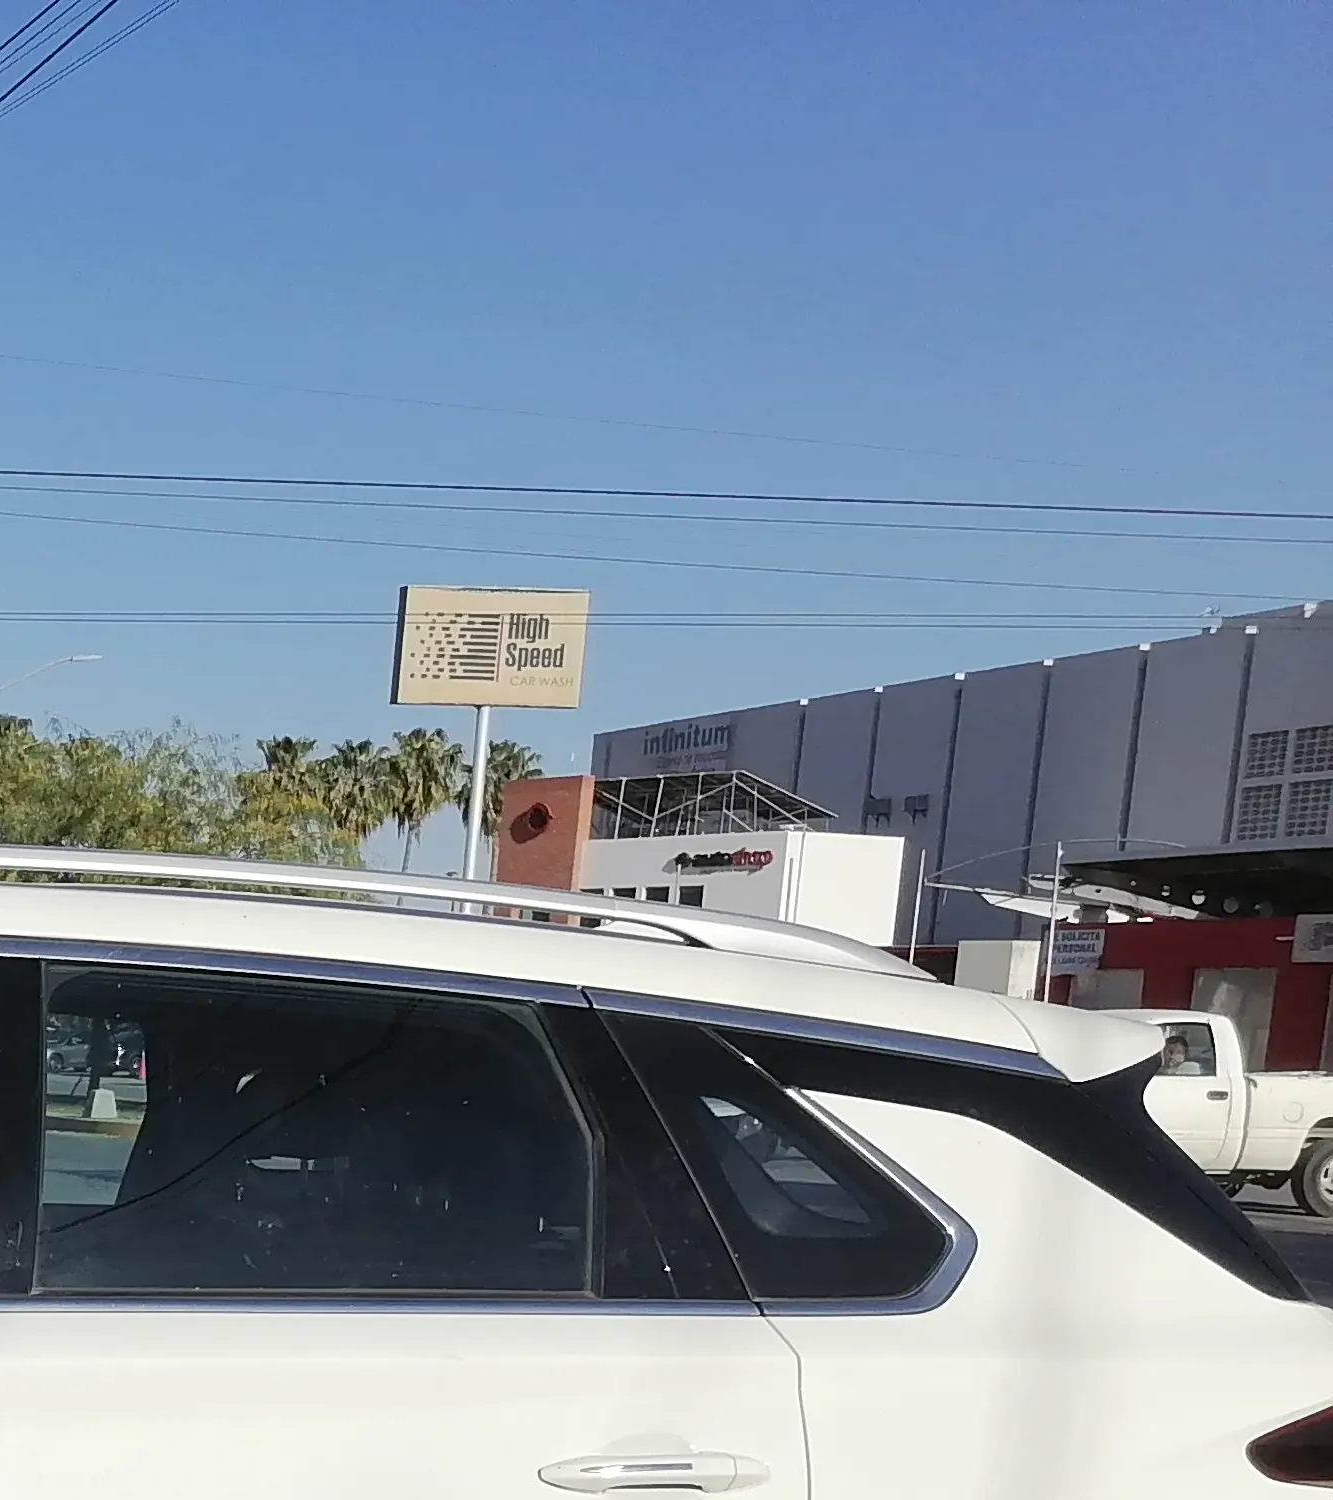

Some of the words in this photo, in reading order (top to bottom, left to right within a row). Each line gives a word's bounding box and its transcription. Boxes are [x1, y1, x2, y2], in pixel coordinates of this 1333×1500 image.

[507, 613, 551, 644] High
[505, 642, 565, 671] Speed
[510, 675, 536, 687] CAR
[539, 676, 574, 687] WASH
[643, 723, 731, 756] infinitum
